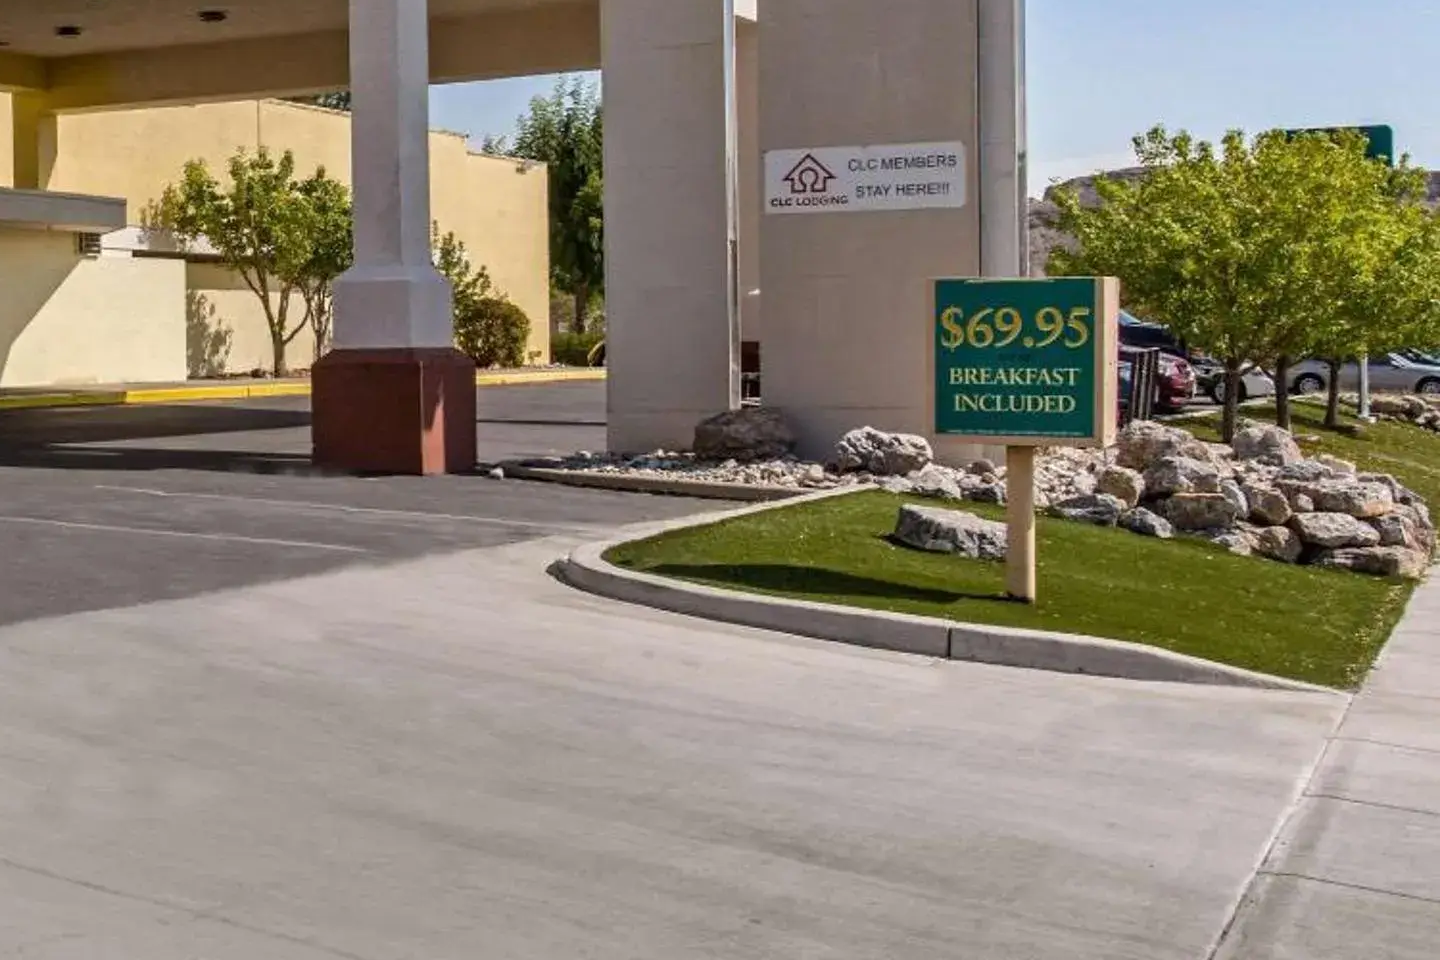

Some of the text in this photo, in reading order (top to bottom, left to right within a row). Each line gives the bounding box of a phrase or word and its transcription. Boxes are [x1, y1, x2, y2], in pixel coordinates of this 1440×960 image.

[848, 154, 958, 172] CLC MEMBERS
[855, 183, 892, 199] STAY
[771, 195, 849, 208] CLC LODGING
[940, 304, 1090, 353] $69.95
[949, 367, 1082, 386] BREAKFAST
[953, 394, 1077, 412] INCLUDED
